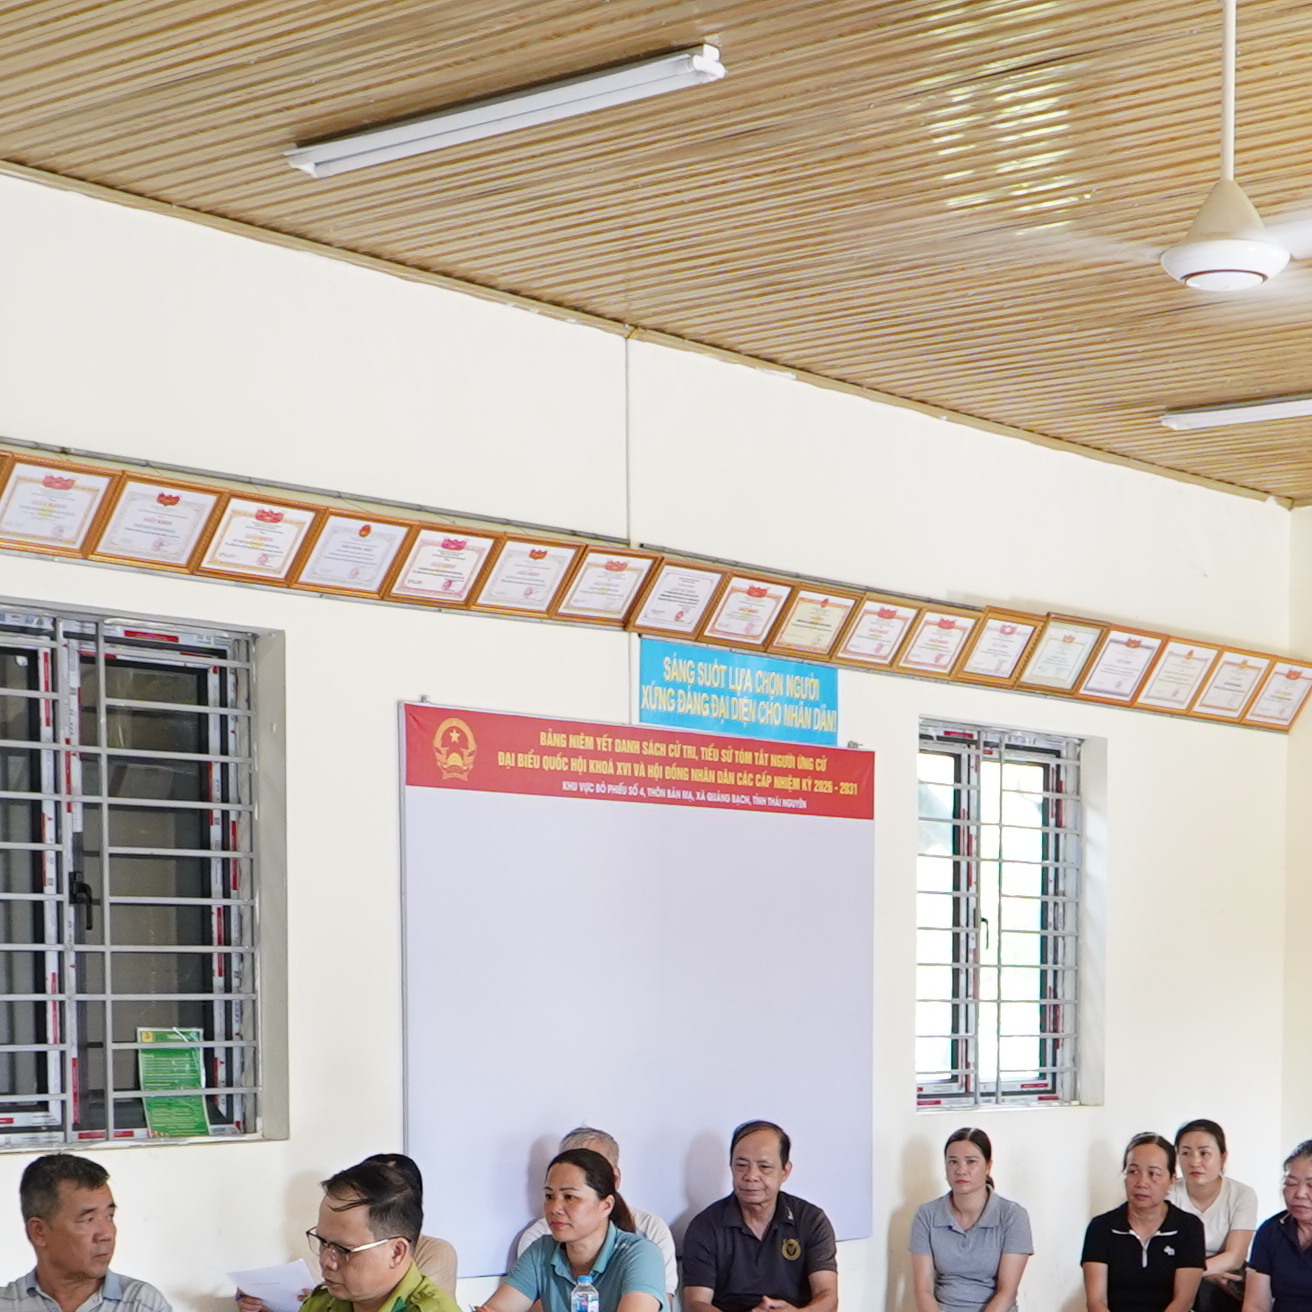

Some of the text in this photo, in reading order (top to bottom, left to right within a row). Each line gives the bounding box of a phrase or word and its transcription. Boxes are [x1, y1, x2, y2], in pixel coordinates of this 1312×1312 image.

[663, 652, 695, 684] SÁNG
[729, 666, 753, 696] LỰA
[755, 670, 784, 700] CHỌN
[785, 672, 820, 702] NGƯỜI
[641, 680, 675, 712] XỨNG
[677, 685, 710, 717] ĐÁNG
[711, 693, 729, 725] ĐẠI
[731, 696, 756, 728] DIỆN
[758, 702, 781, 726] CHO
[784, 701, 811, 730] NHÂN
[498, 751, 515, 769] ĐẠI
[517, 749, 540, 768] BIỂU
[542, 753, 569, 771] QUỐC
[571, 755, 586, 775] HỘI
[589, 759, 614, 775] KHOÁ
[616, 761, 631, 776] XVI
[633, 761, 645, 777] VÀ
[648, 763, 662, 781] HỘI
[691, 767, 715, 783] NHÂN
[736, 771, 753, 786] CÁC
[755, 771, 772, 788] CẤP
[540, 728, 567, 747] BẢNG
[596, 733, 613, 751] YẾT
[615, 739, 640, 754] DANH
[642, 740, 666, 756] SÁCH
[669, 740, 681, 757] CỬ
[721, 745, 733, 763] SỬ
[735, 749, 752, 765] TÓM
[754, 748, 769, 766] TẮT
[815, 755, 828, 771] CỬ
[628, 782, 639, 796] SỐ
